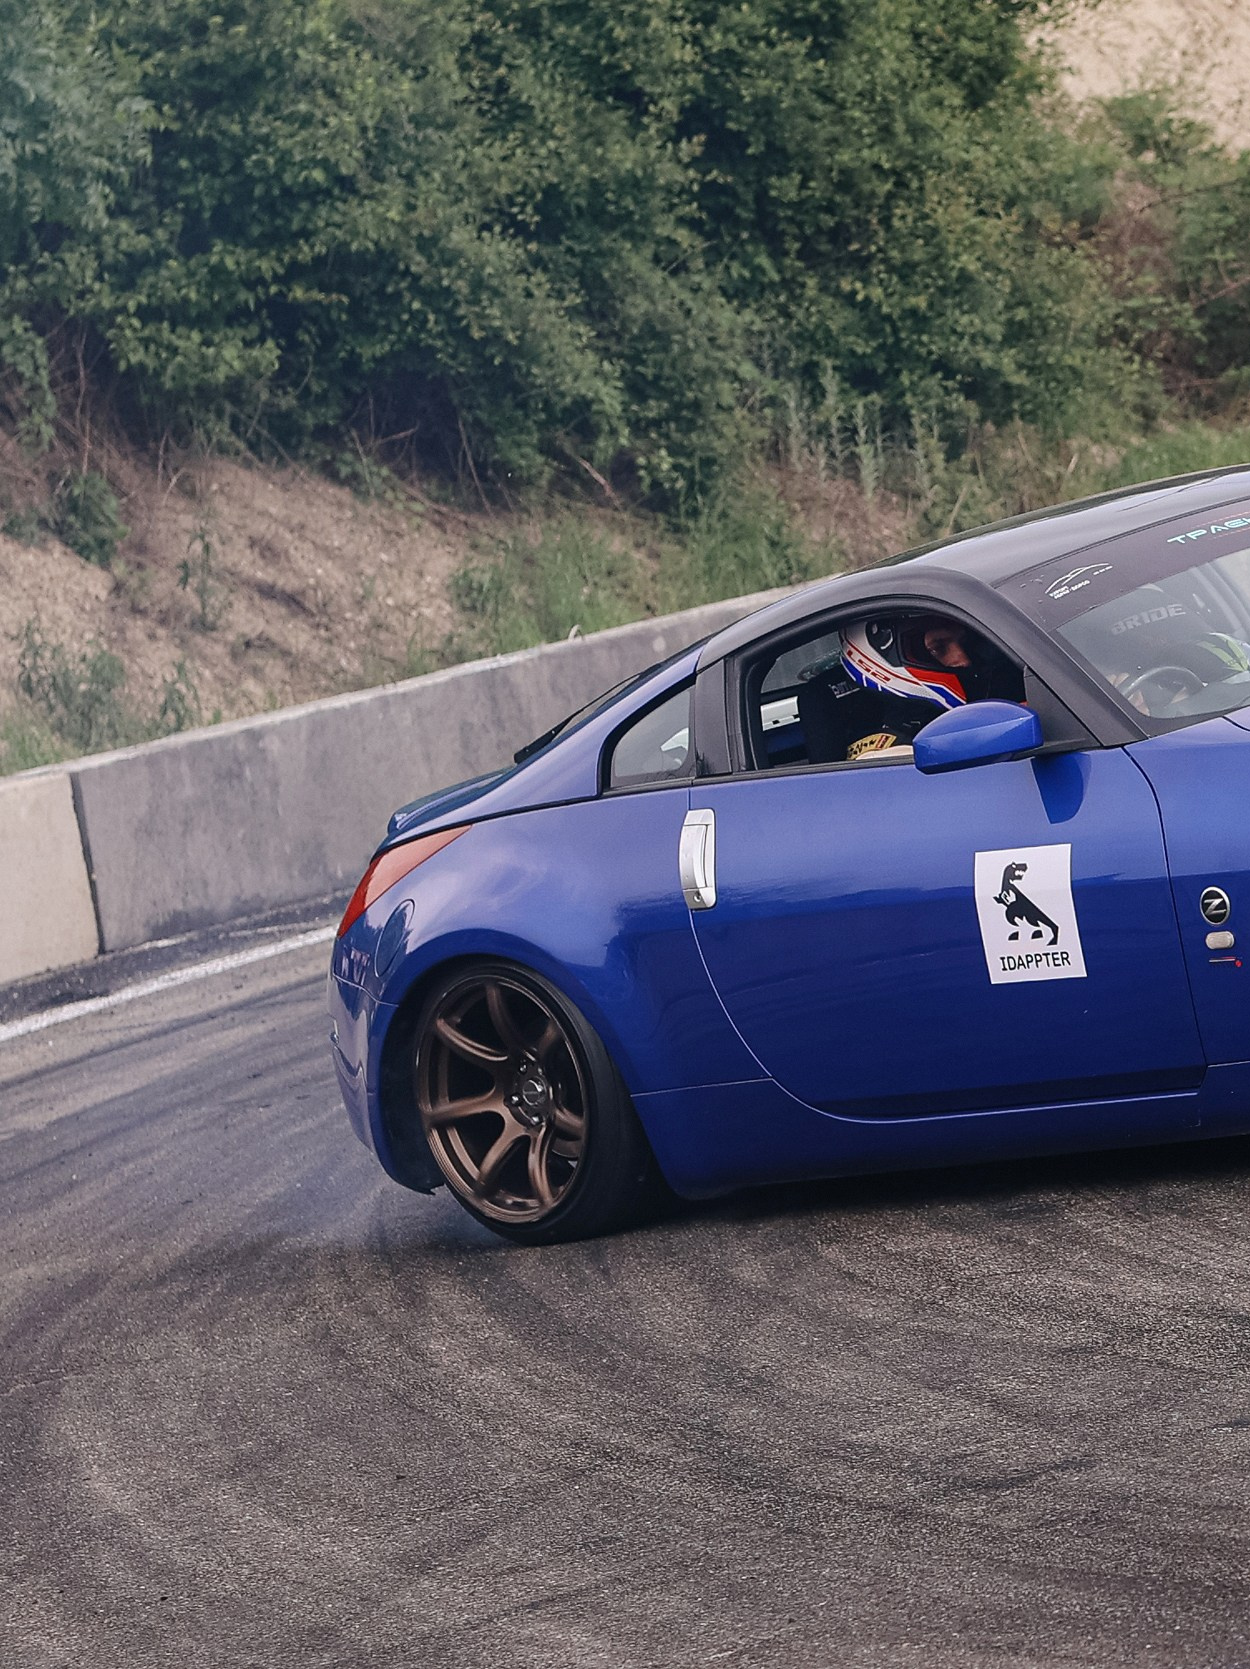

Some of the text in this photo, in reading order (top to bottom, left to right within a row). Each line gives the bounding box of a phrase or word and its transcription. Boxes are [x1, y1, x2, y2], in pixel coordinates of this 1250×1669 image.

[846, 649, 892, 685] LS2
[1204, 898, 1227, 916] Z
[1000, 951, 1071, 972] IDAPPTER
